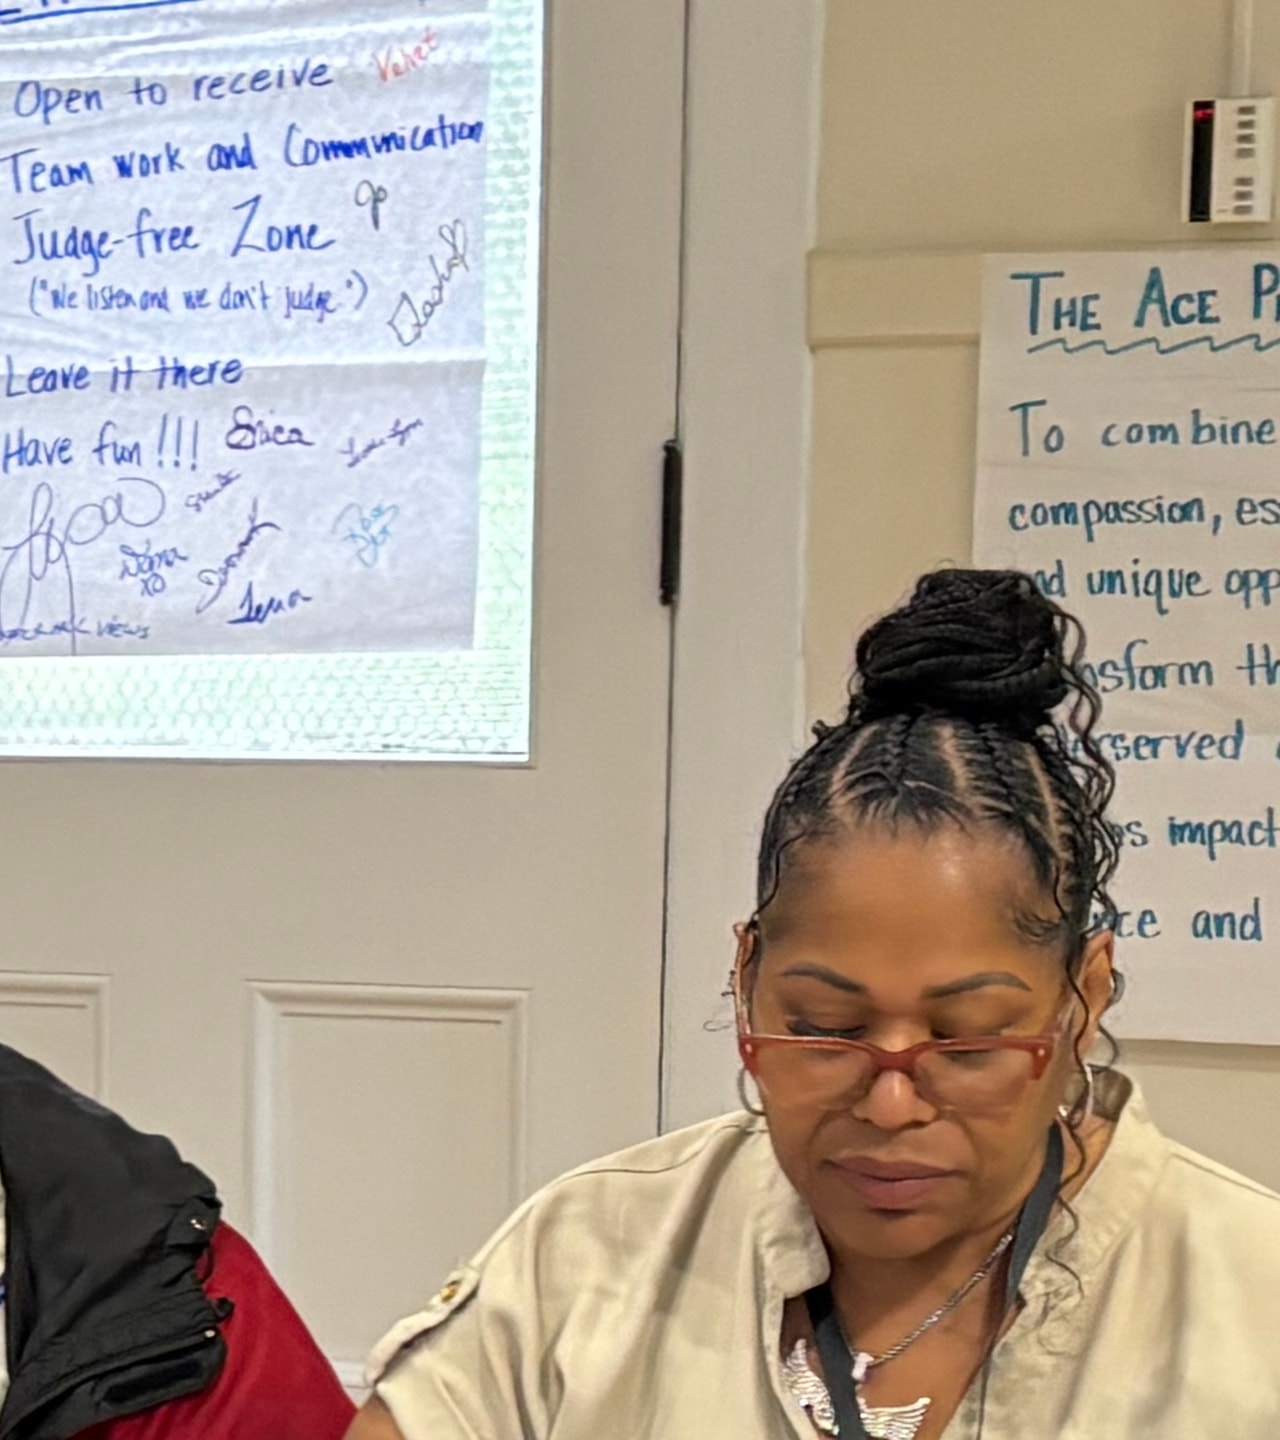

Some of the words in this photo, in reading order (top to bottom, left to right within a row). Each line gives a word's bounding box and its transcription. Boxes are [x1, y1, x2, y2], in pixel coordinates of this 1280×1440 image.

[14, 80, 104, 125] Open
[128, 77, 168, 105] to
[193, 58, 334, 101] receive
[112, 142, 185, 179] work
[207, 131, 258, 171] and
[284, 114, 484, 167] Communication
[230, 194, 336, 257] Zone
[86, 284, 133, 310] listen
[138, 285, 172, 312] and
[182, 288, 212, 310] we
[218, 280, 271, 311] don't
[1009, 270, 1102, 335] THE
[1134, 266, 1221, 327] ACE
[6, 354, 91, 398] Leave
[108, 356, 144, 393] it
[150, 356, 243, 390] there
[2, 427, 74, 474] Have
[1008, 398, 1065, 457] To
[1101, 408, 1277, 447] combine
[1007, 495, 1222, 542] compassion,
[1032, 558, 1067, 598] nd
[1086, 557, 1212, 616] unique
[1167, 806, 1280, 862] impact
[1191, 896, 1263, 942] and
